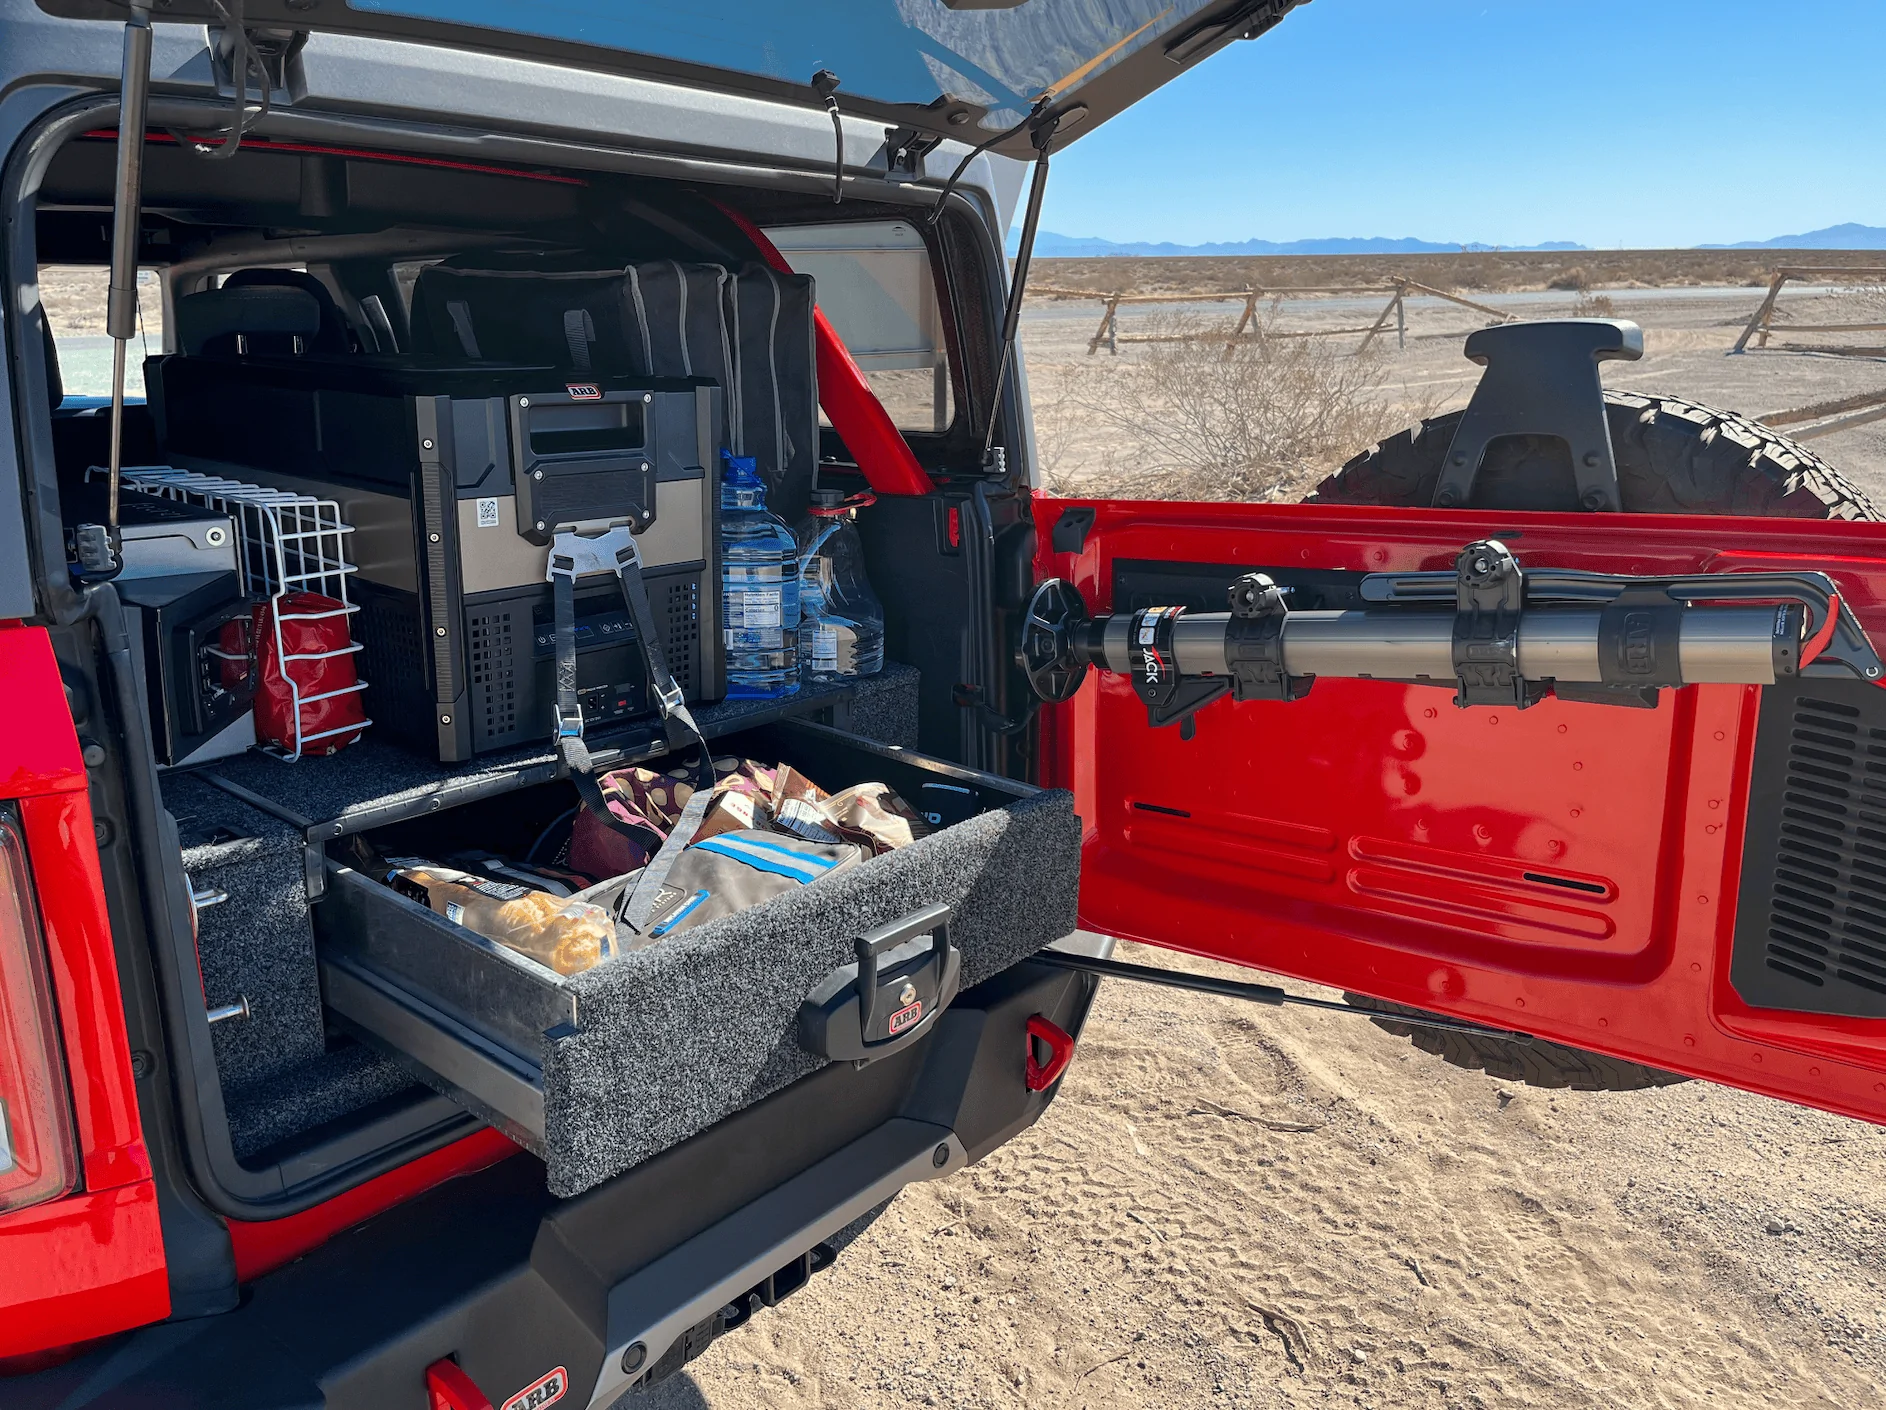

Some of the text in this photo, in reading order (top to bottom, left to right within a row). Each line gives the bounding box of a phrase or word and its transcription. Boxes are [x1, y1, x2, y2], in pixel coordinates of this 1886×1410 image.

[571, 387, 597, 396] ARB
[1142, 647, 1159, 684] JACK
[893, 1007, 918, 1029] ARB
